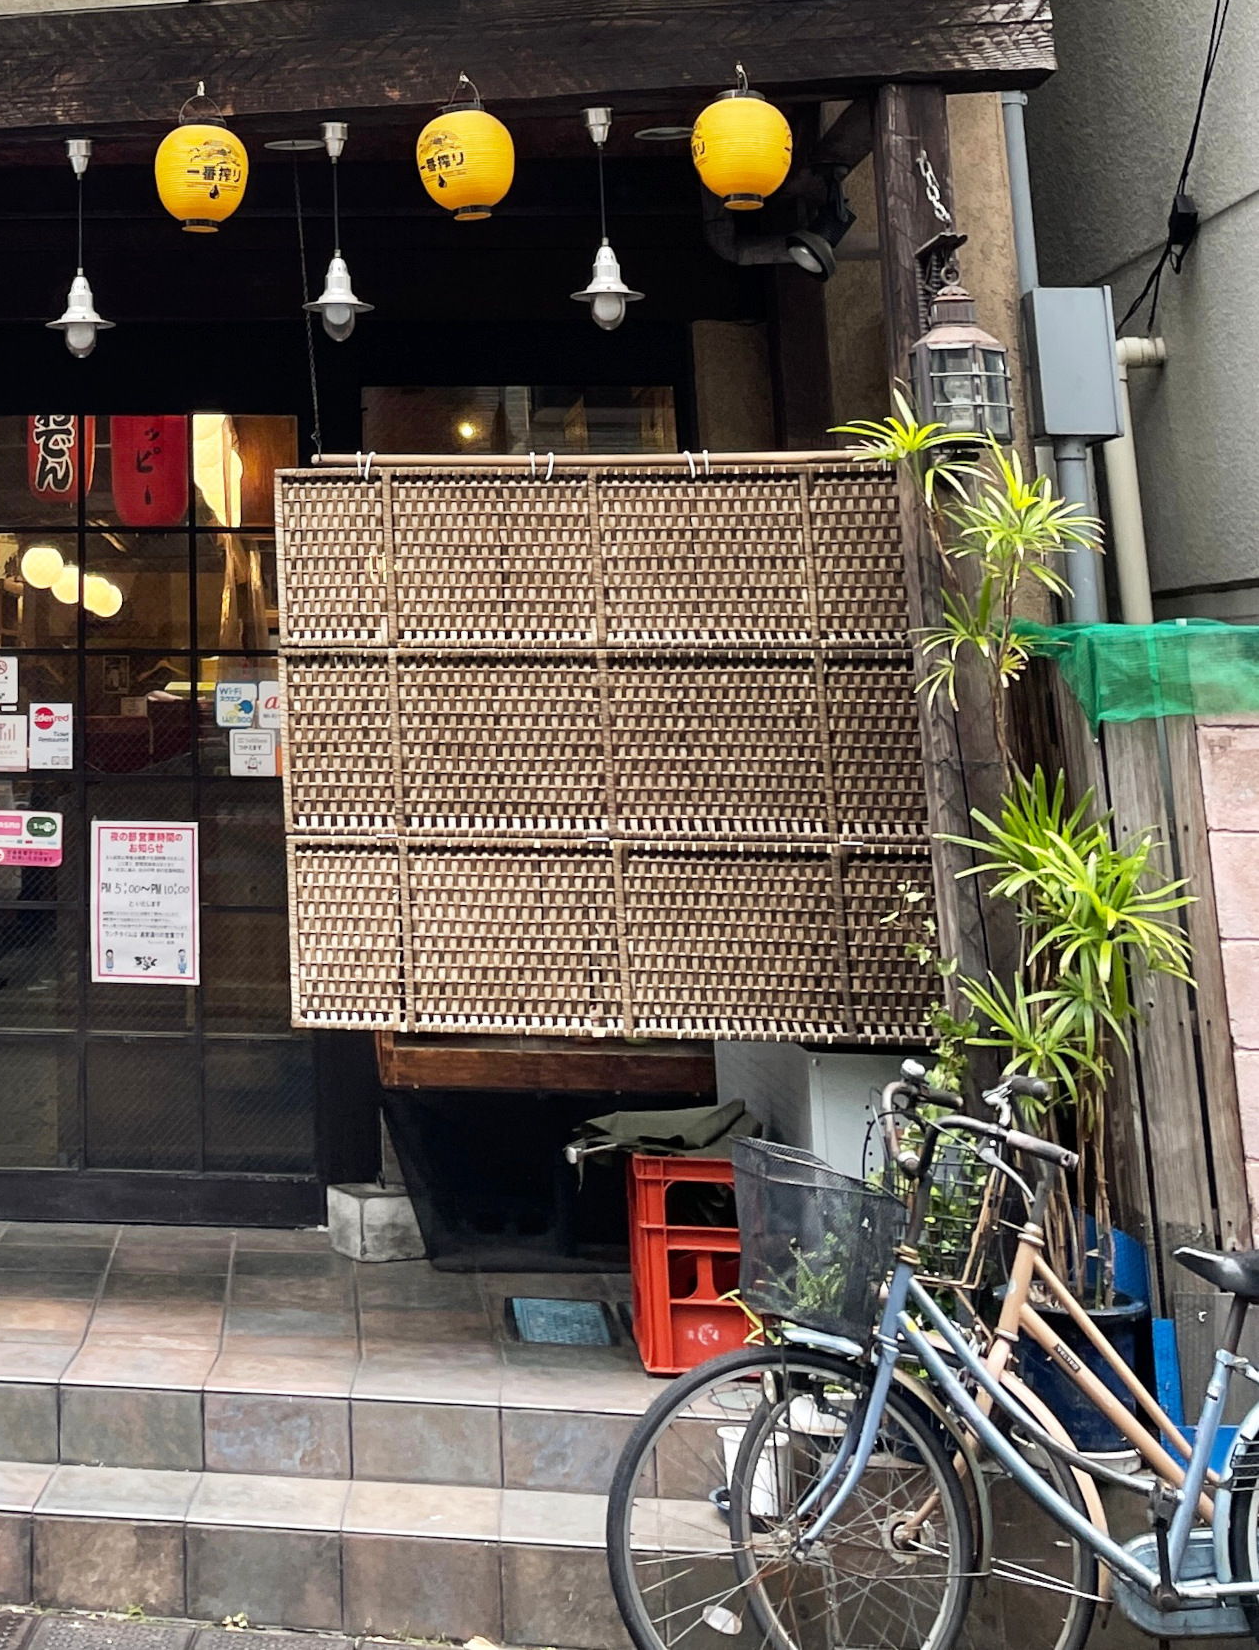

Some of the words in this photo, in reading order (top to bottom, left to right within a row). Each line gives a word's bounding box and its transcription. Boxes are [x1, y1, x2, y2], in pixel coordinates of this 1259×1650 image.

[420, 151, 465, 172] 一番搾り
[186, 165, 242, 184] 一番搾り
[33, 713, 70, 723] Edenred
[128, 843, 164, 854] お知らせ
